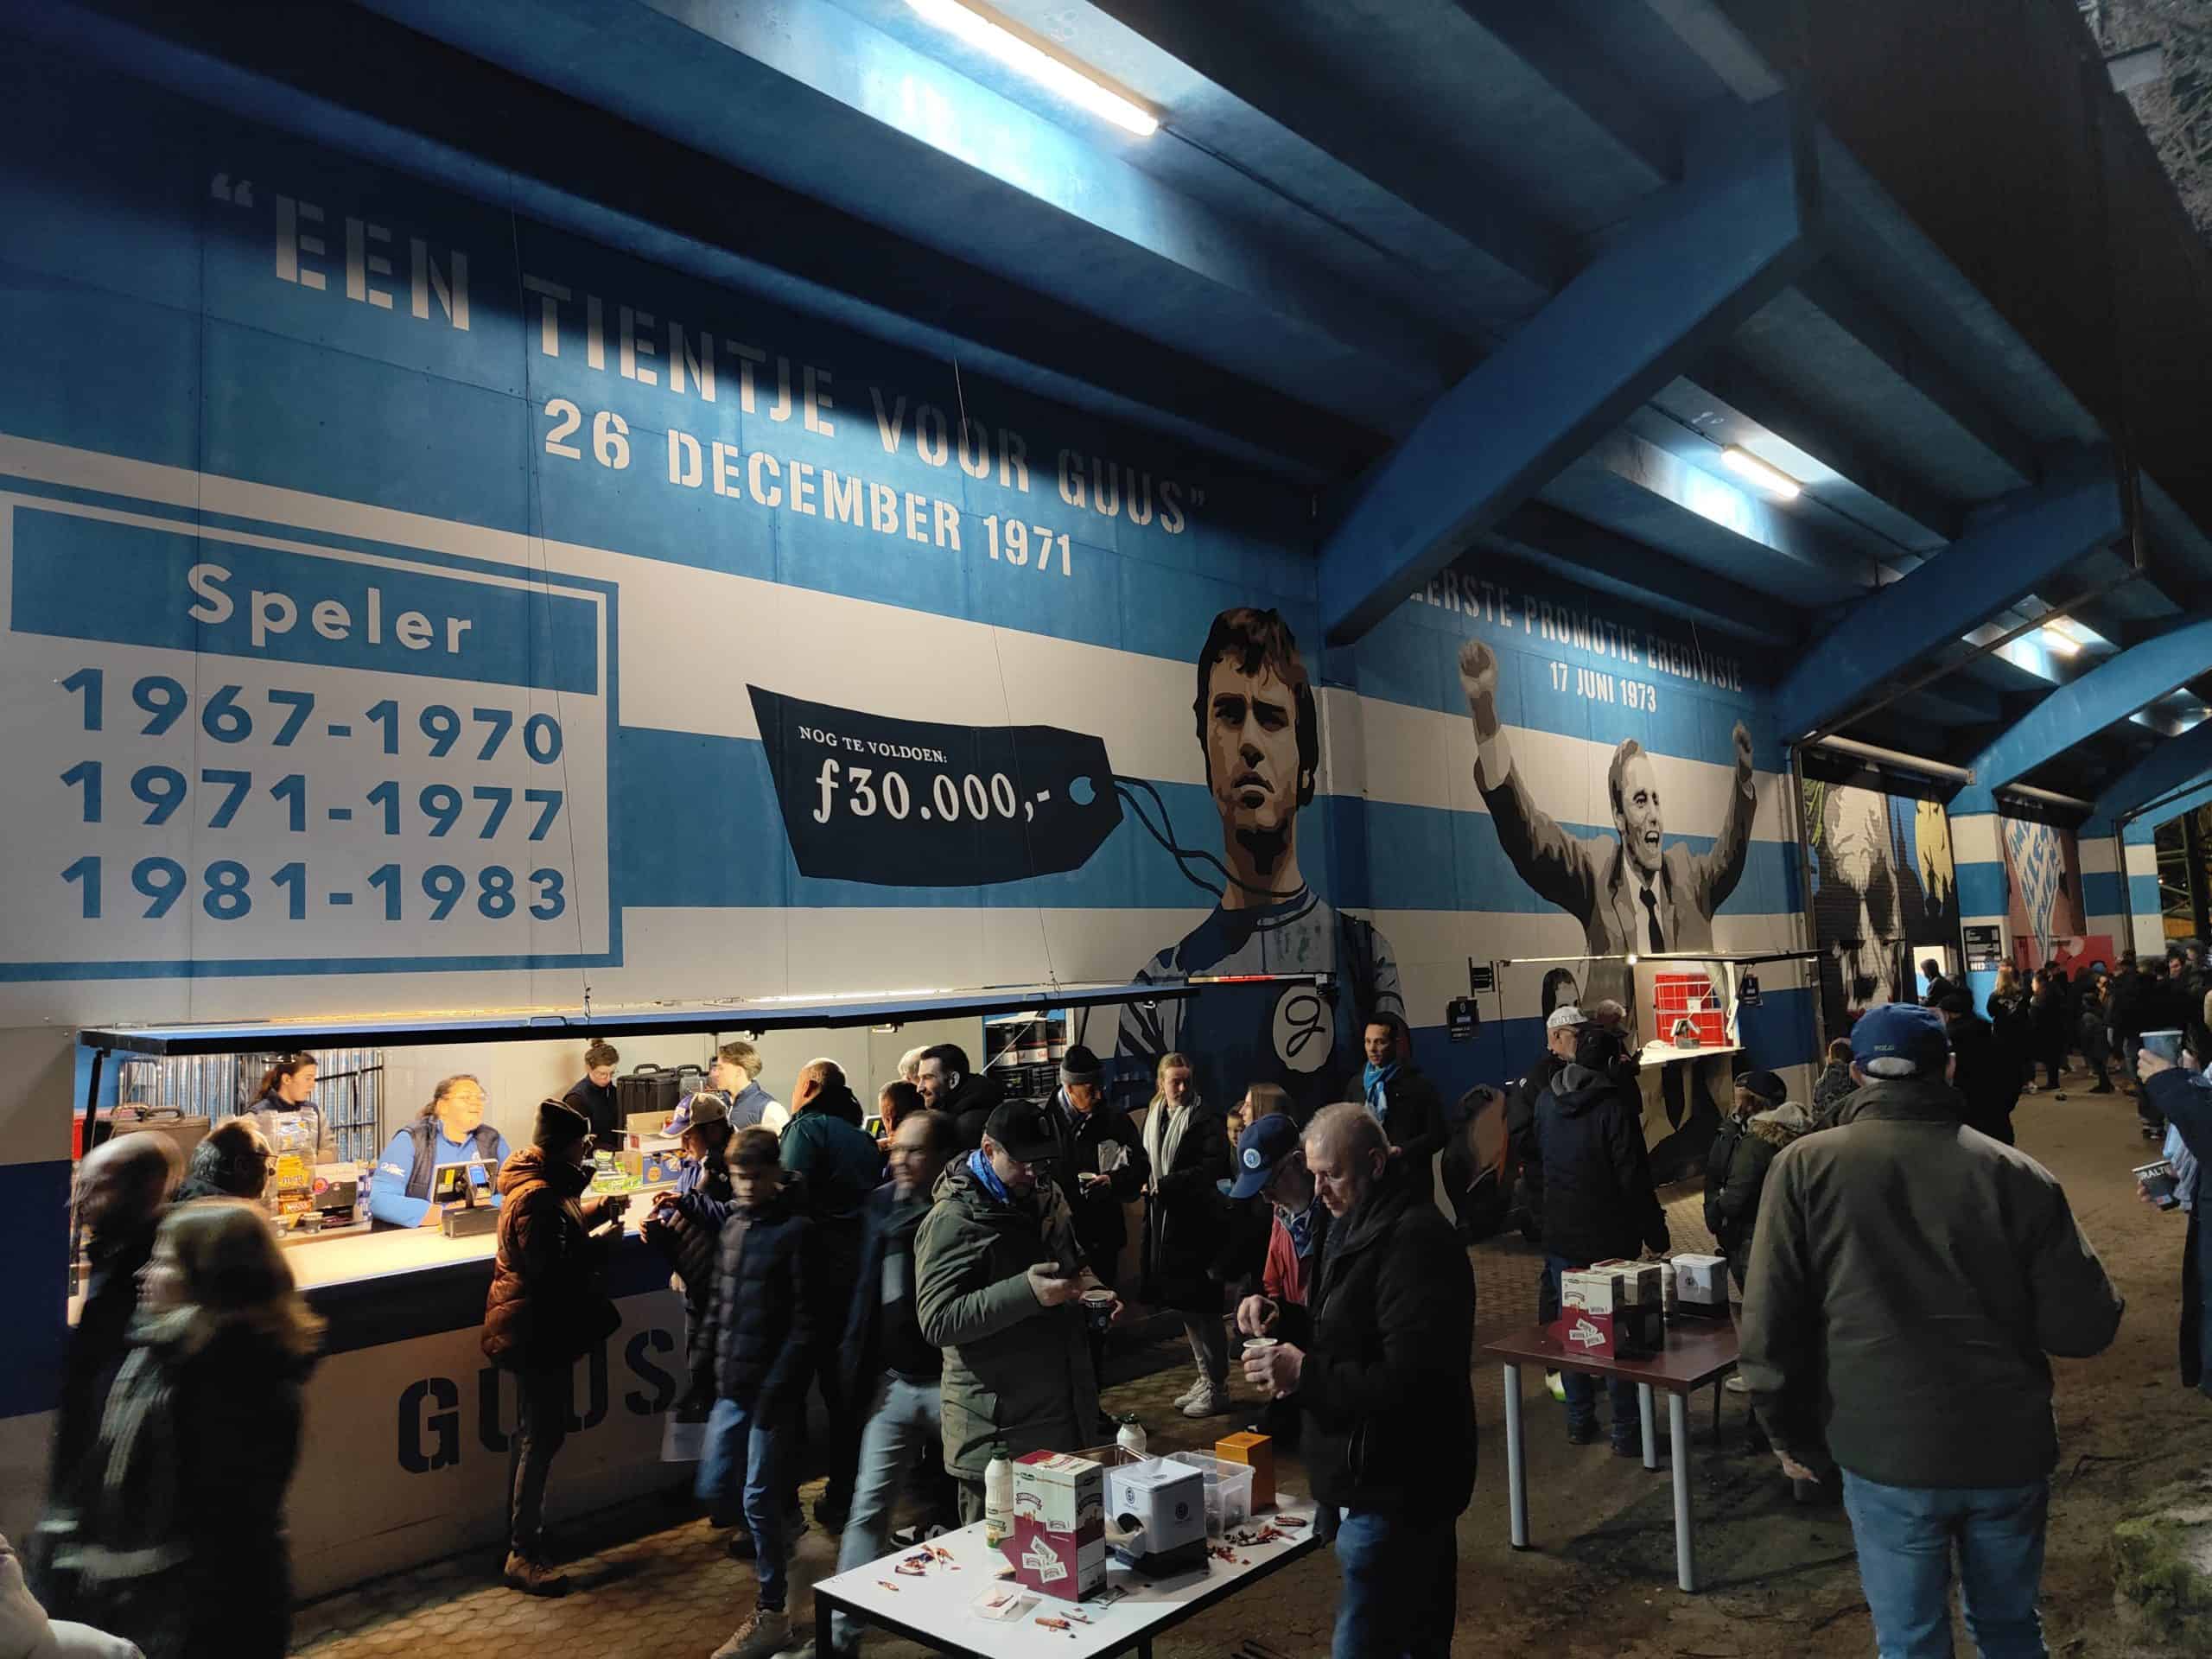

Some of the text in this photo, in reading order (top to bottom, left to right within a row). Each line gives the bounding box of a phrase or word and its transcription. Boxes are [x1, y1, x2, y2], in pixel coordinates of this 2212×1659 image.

[522, 272, 836, 438] TIENTJE
[869, 386, 1030, 493] VOOR
[544, 397, 1071, 576] 26 DECEMBER 1971
[188, 563, 473, 654] Speler
[1410, 570, 1742, 693] ERSTE PROMOTIE EREDIVISIE
[60, 668, 563, 765] 1967-1970
[1549, 662, 1656, 713] 17 JUNI 1973
[798, 726, 948, 763] NOG TE VOLDOEN:
[60, 760, 563, 842] 1971-1977
[60, 855, 566, 922] 1981-1983
